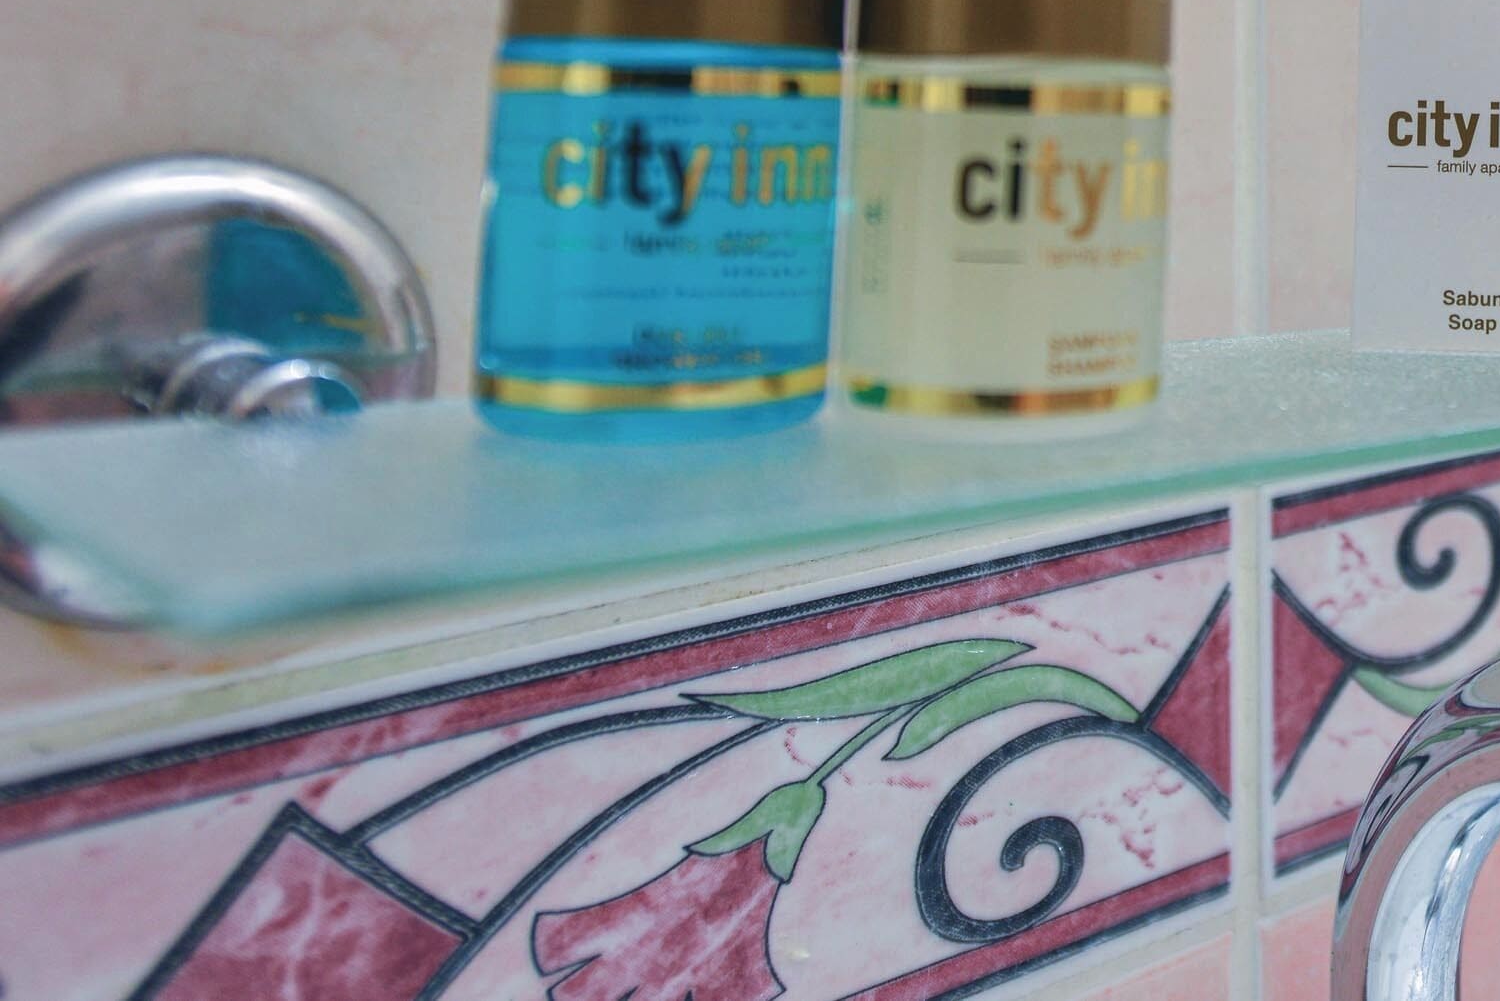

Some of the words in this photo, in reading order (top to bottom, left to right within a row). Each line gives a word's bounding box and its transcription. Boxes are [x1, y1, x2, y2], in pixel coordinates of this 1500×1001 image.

[1388, 100, 1480, 158] city
[540, 119, 712, 227] city
[956, 136, 1111, 240] city
[1437, 160, 1476, 175] family
[1448, 314, 1497, 334] Soap
